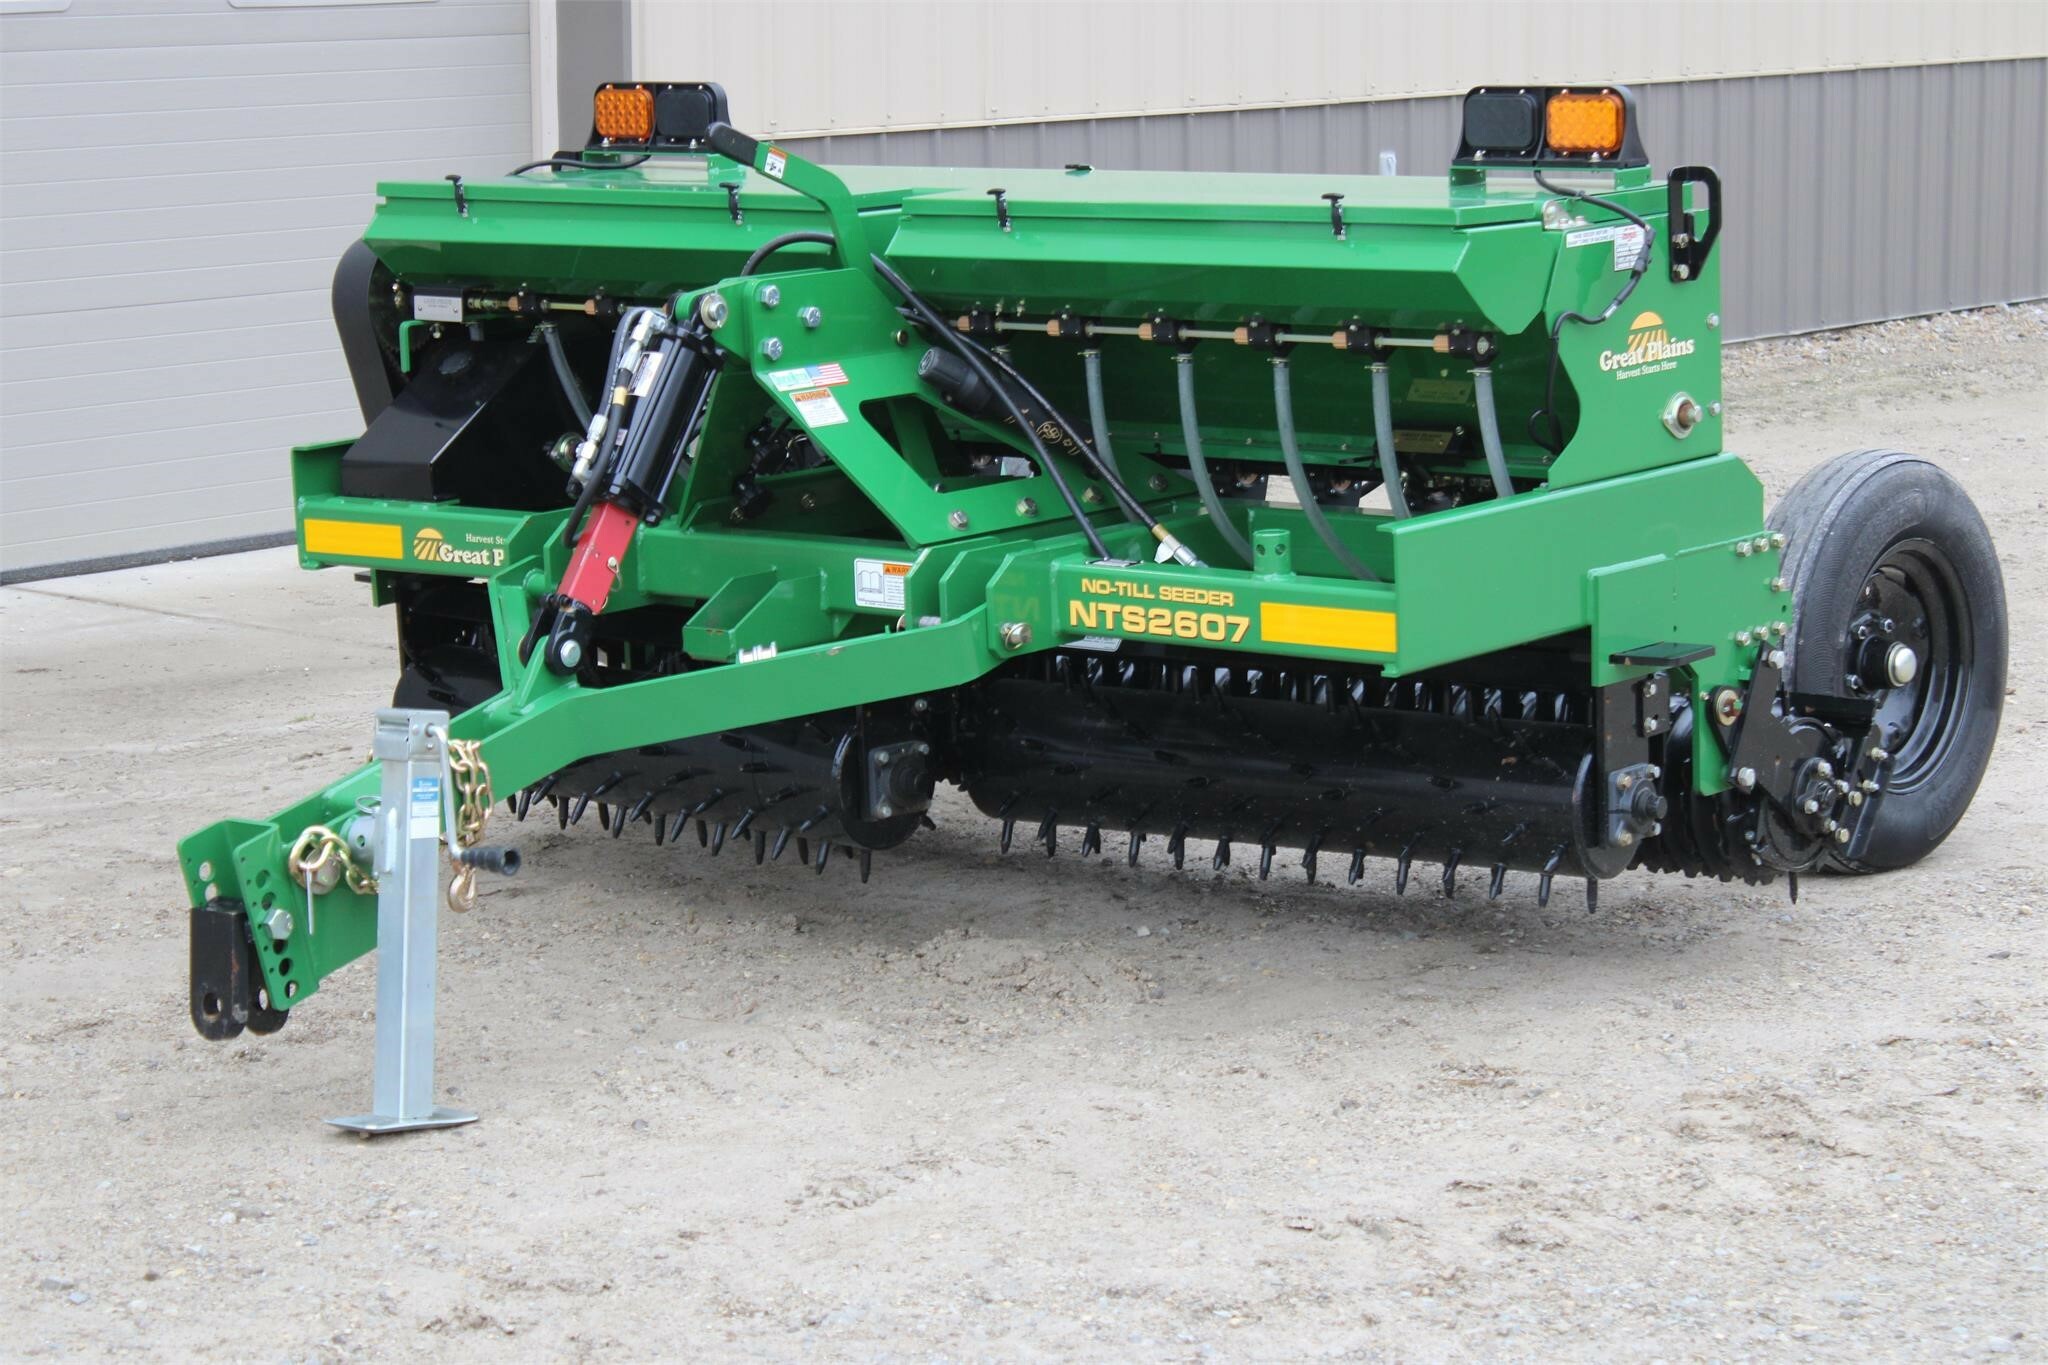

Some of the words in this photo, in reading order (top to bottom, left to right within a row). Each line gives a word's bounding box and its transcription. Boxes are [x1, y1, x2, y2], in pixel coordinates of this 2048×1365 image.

[1600, 346, 1643, 371] Great
[1647, 338, 1695, 362] Plains
[1616, 367, 1642, 380] Harvest
[1642, 364, 1661, 376] Starts
[1661, 361, 1678, 371] Here
[466, 533, 494, 544] Harvest
[439, 544, 490, 566] Great
[1081, 578, 1155, 599] NO-TILL
[1159, 586, 1234, 608] SEEDER
[1069, 600, 1250, 643] NTS2607
